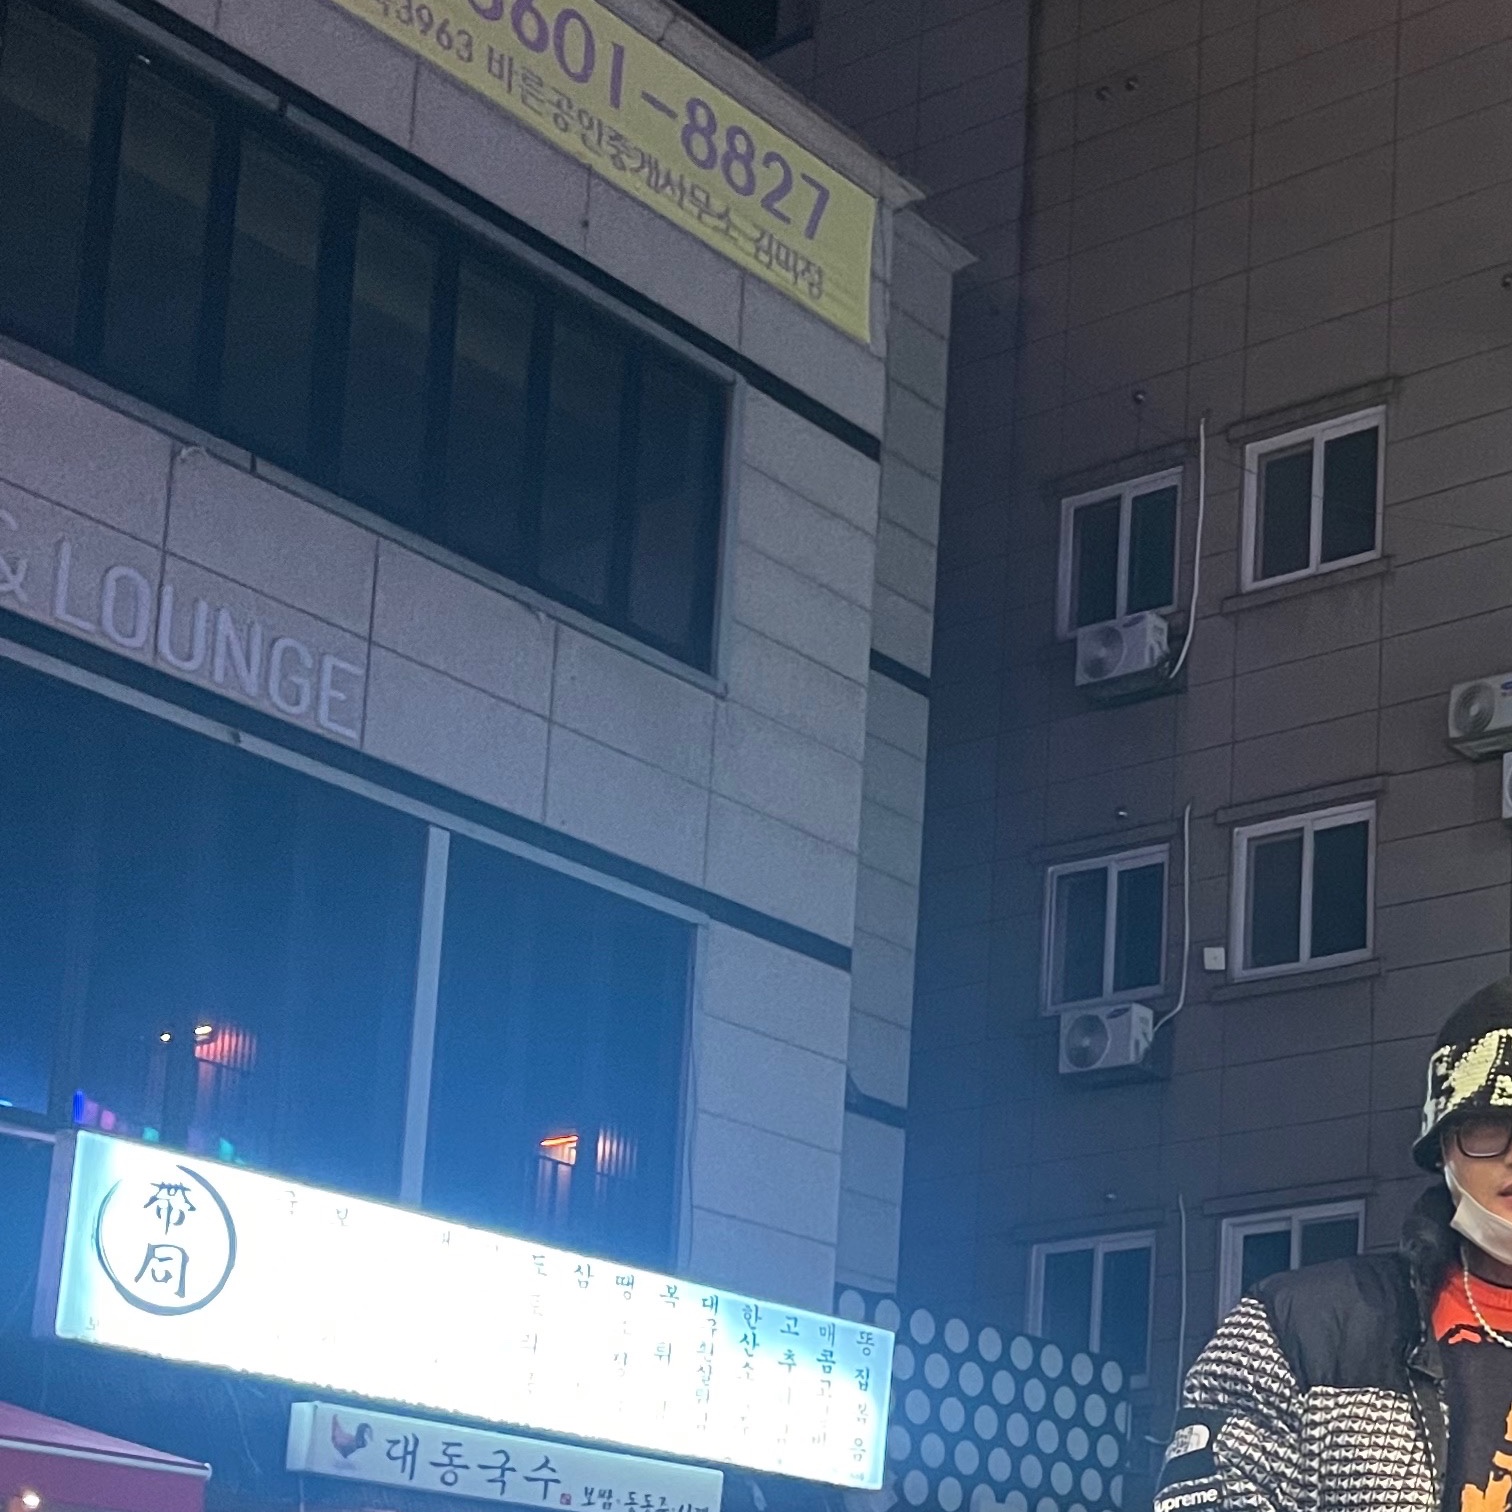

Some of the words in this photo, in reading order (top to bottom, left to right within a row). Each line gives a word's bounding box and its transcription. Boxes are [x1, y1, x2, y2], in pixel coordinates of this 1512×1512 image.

[465, 0, 831, 240] 601-8827
[54, 535, 364, 742] LOUNGE
[385, 1432, 562, 1500] 대동국수
